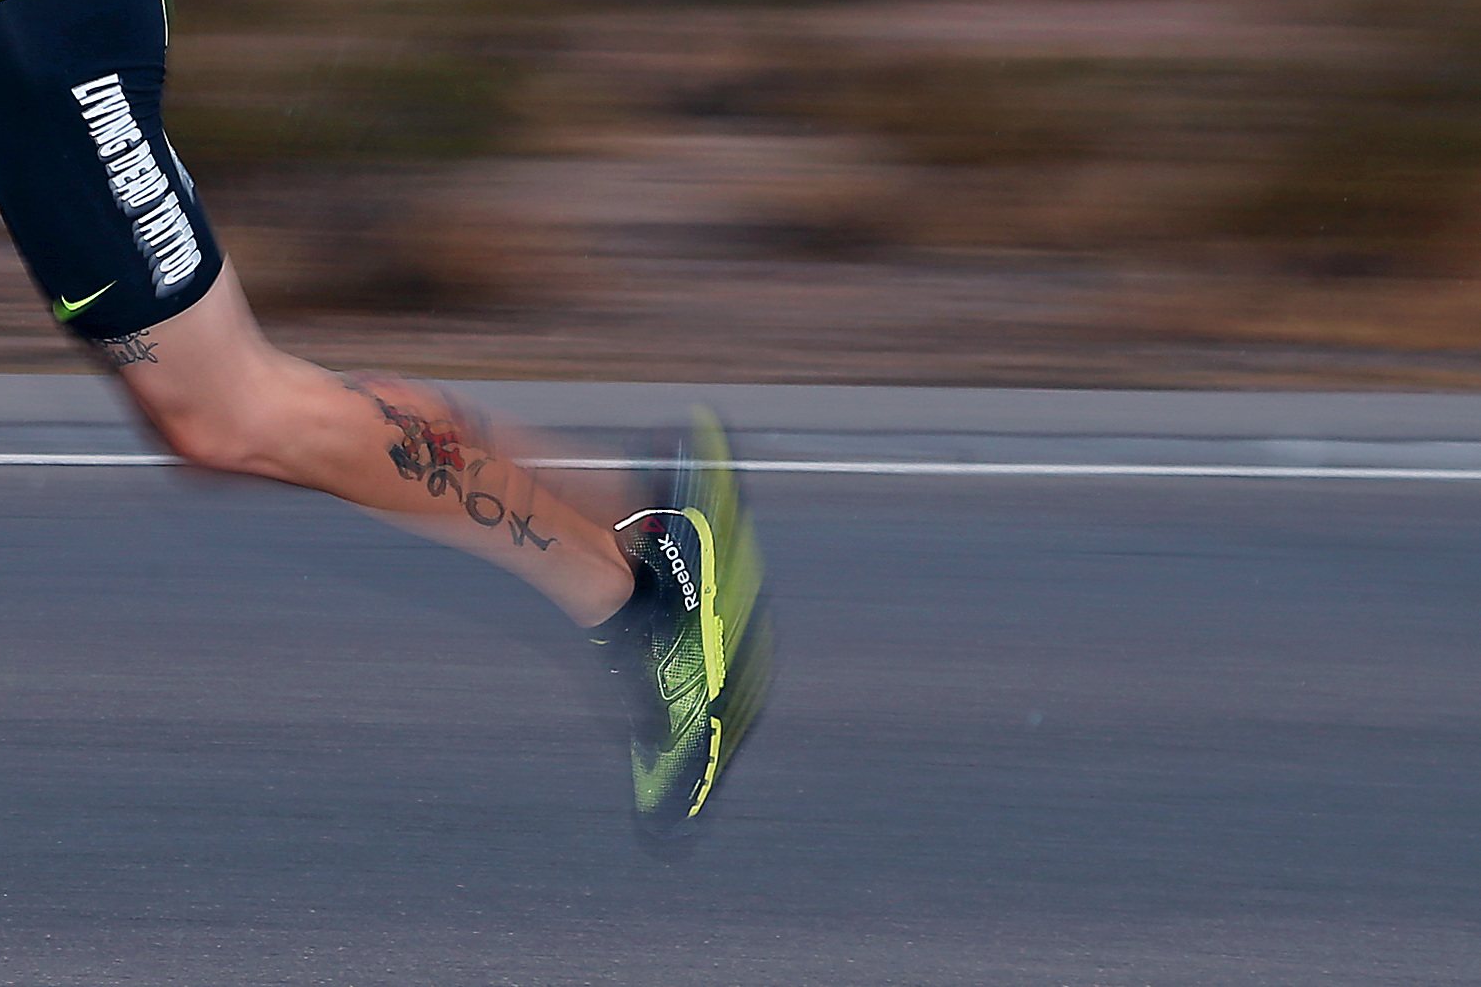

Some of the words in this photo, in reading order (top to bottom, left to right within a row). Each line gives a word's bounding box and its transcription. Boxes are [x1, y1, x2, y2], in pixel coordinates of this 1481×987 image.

[71, 73, 143, 158] LIVING
[107, 139, 169, 210] DEAD
[135, 191, 202, 289] TATTOO
[657, 533, 700, 611] Reebok
